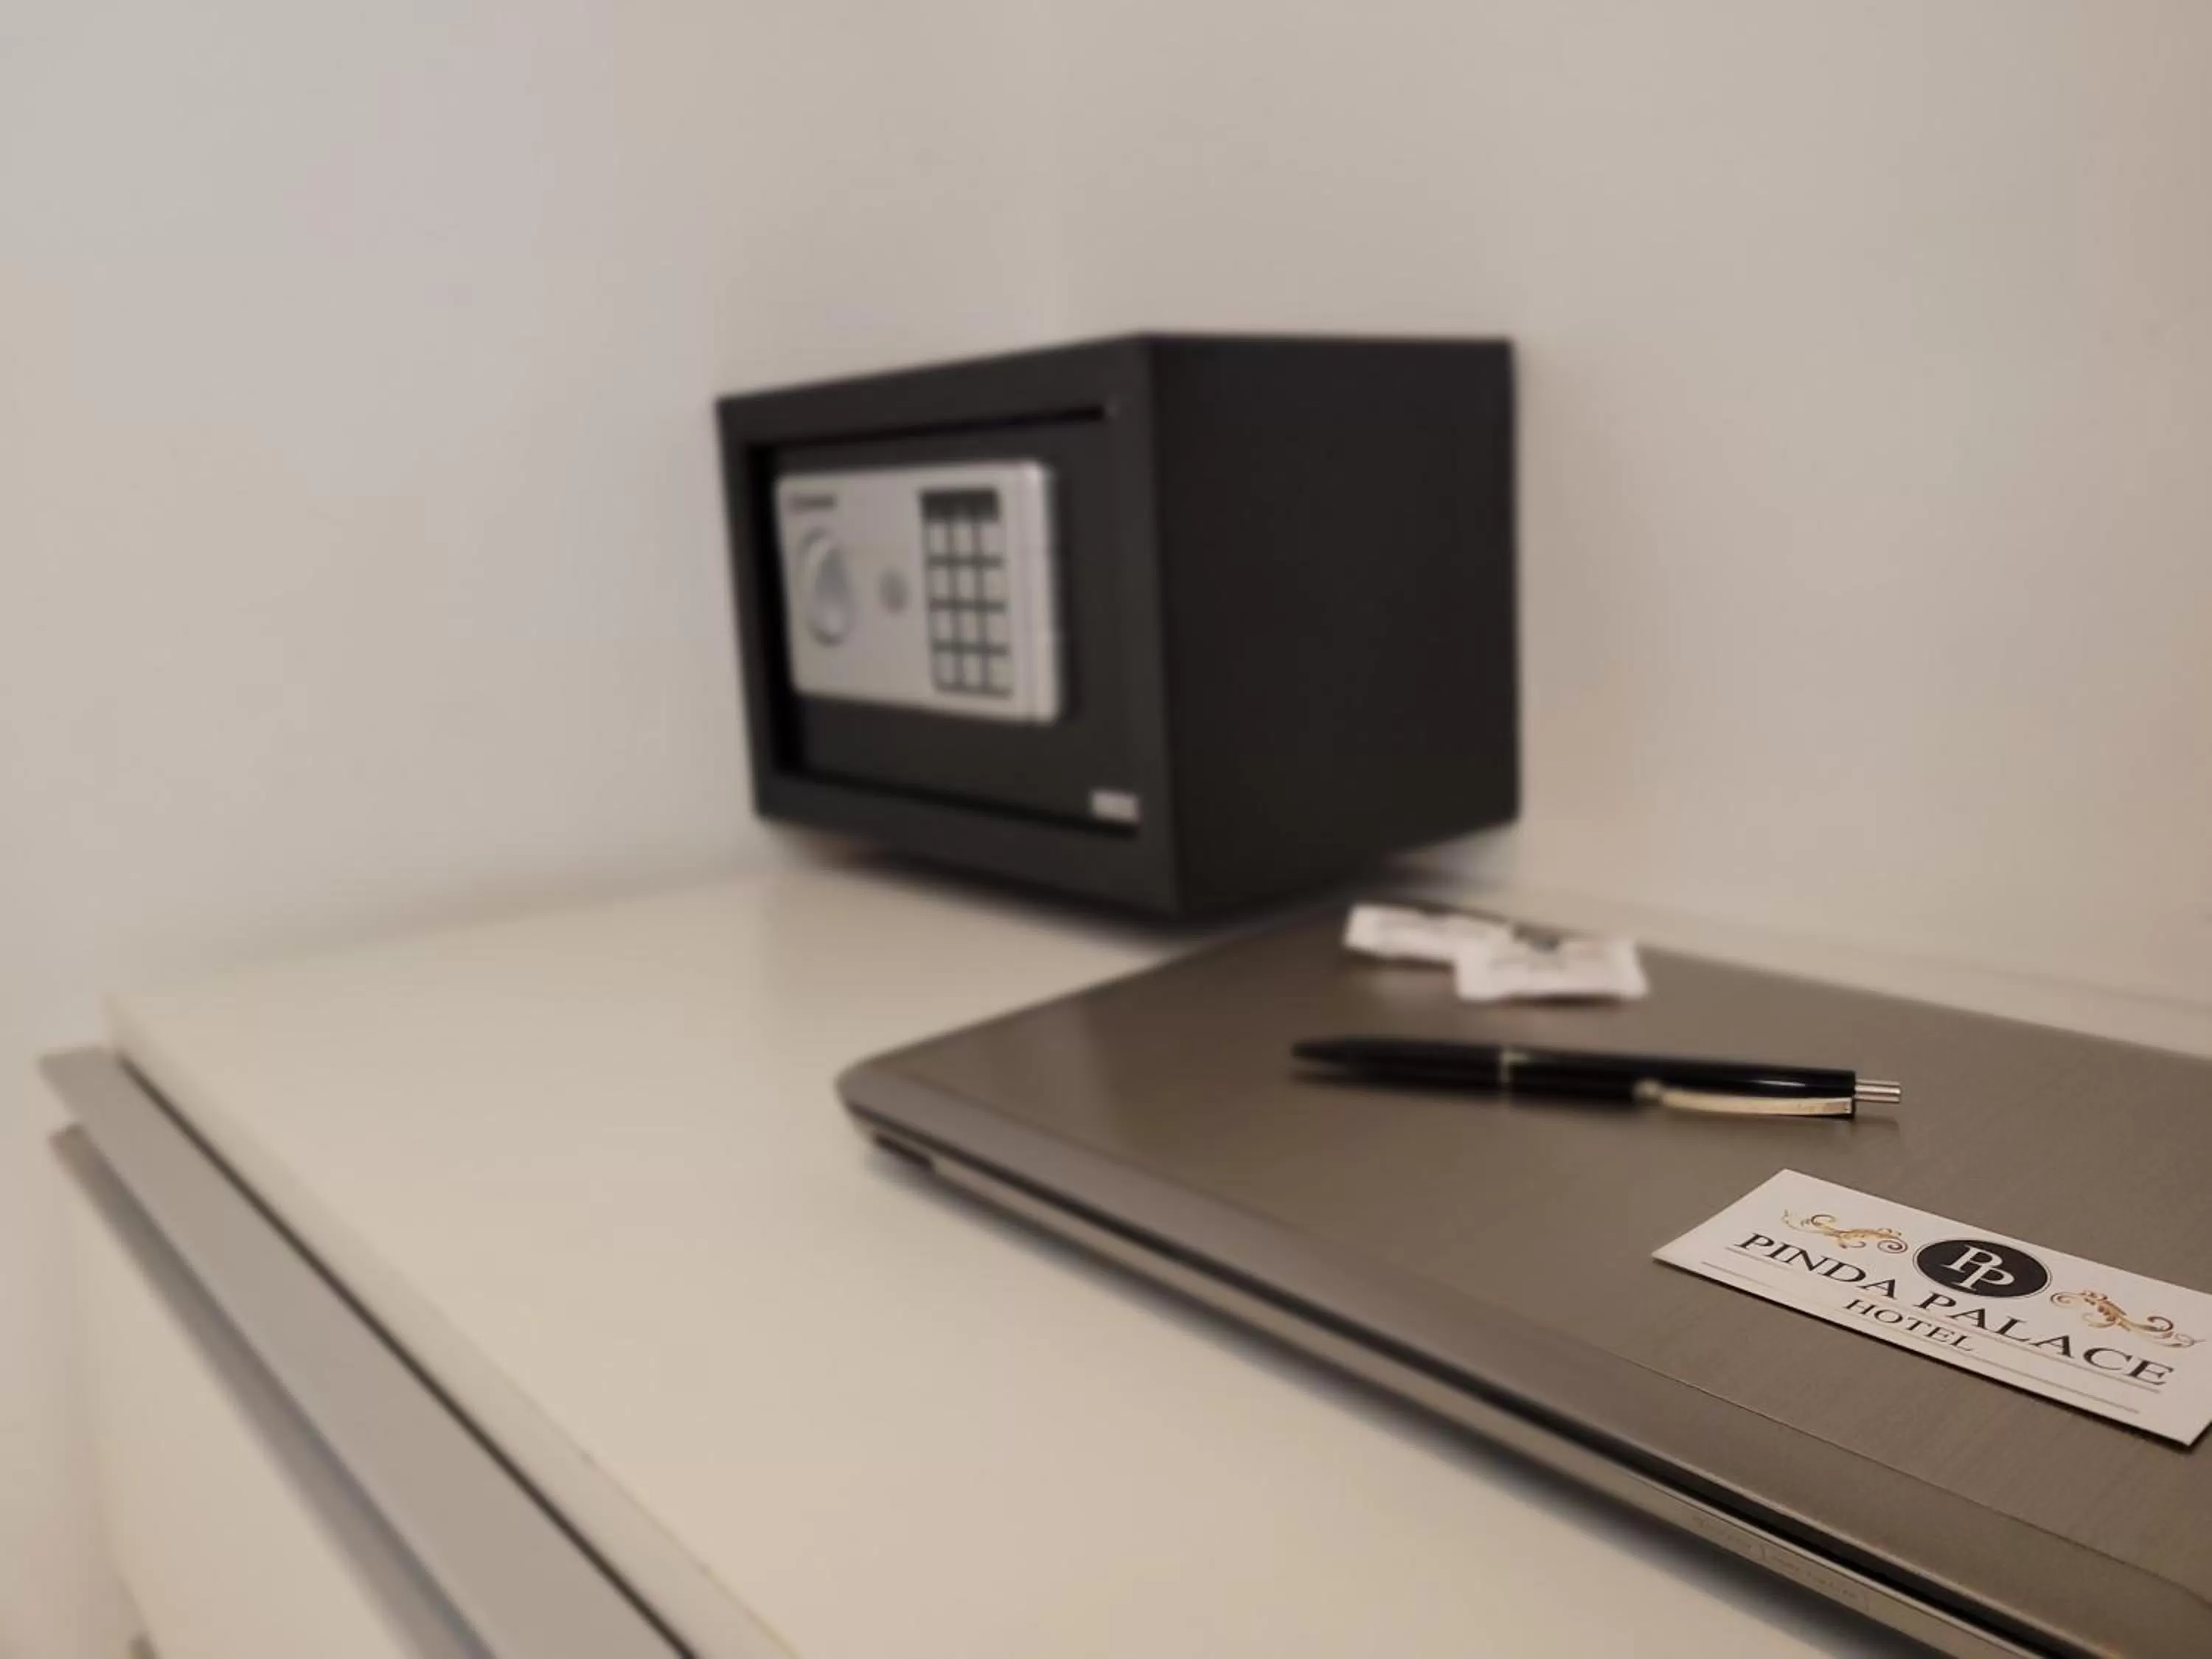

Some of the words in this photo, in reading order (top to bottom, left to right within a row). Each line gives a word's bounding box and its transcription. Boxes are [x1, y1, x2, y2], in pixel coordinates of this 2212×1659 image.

[1734, 1232, 1899, 1300] PINDA
[1913, 1291, 2175, 1385] PALACE
[1843, 1298, 1974, 1352] HOTEL
